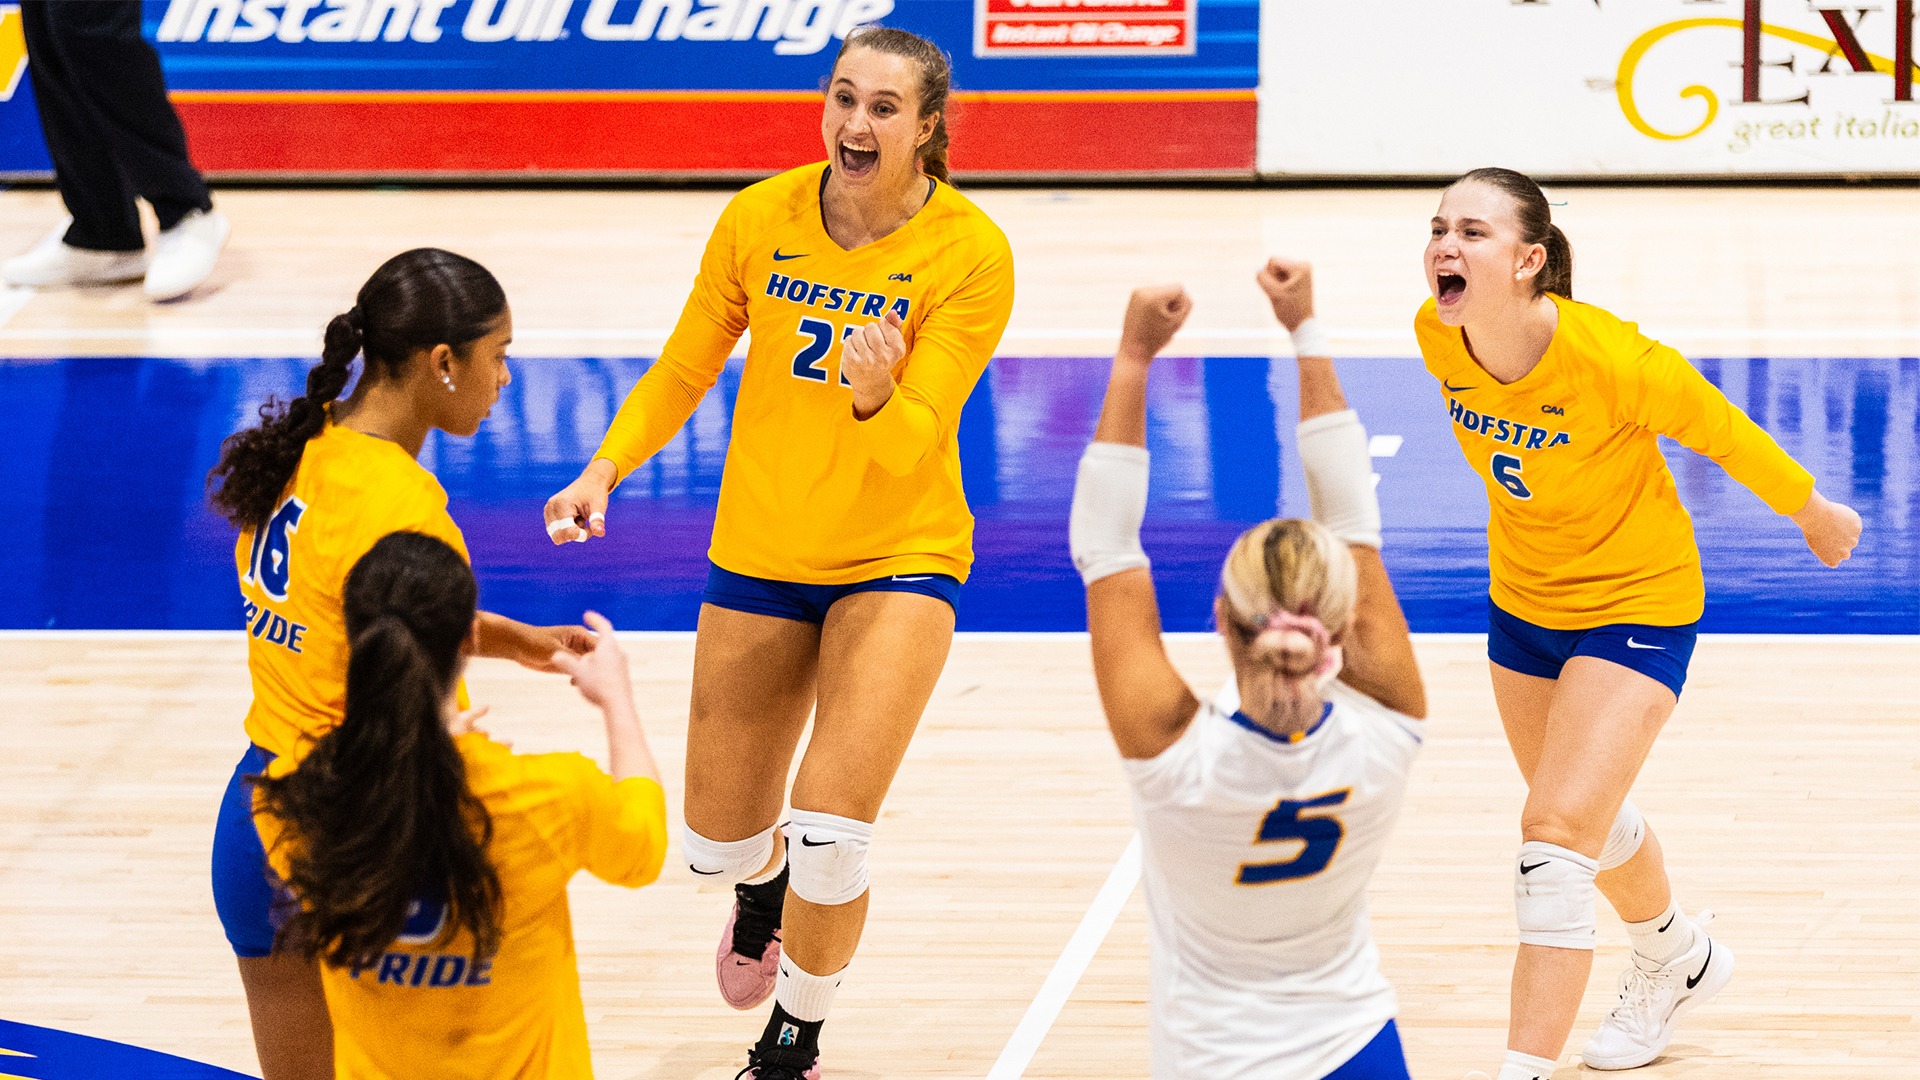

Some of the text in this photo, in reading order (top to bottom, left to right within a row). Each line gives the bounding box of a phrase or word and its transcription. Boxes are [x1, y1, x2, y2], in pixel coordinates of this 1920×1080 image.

[156, 0, 454, 43] Instant
[580, 0, 895, 55] Change
[1728, 117, 1820, 153] great
[764, 271, 911, 322] HOFSTRA
[1449, 396, 1571, 450] HOFSTRA
[1541, 404, 1565, 416] CAA
[1490, 451, 1533, 501] 6
[1233, 787, 1353, 888] 5
